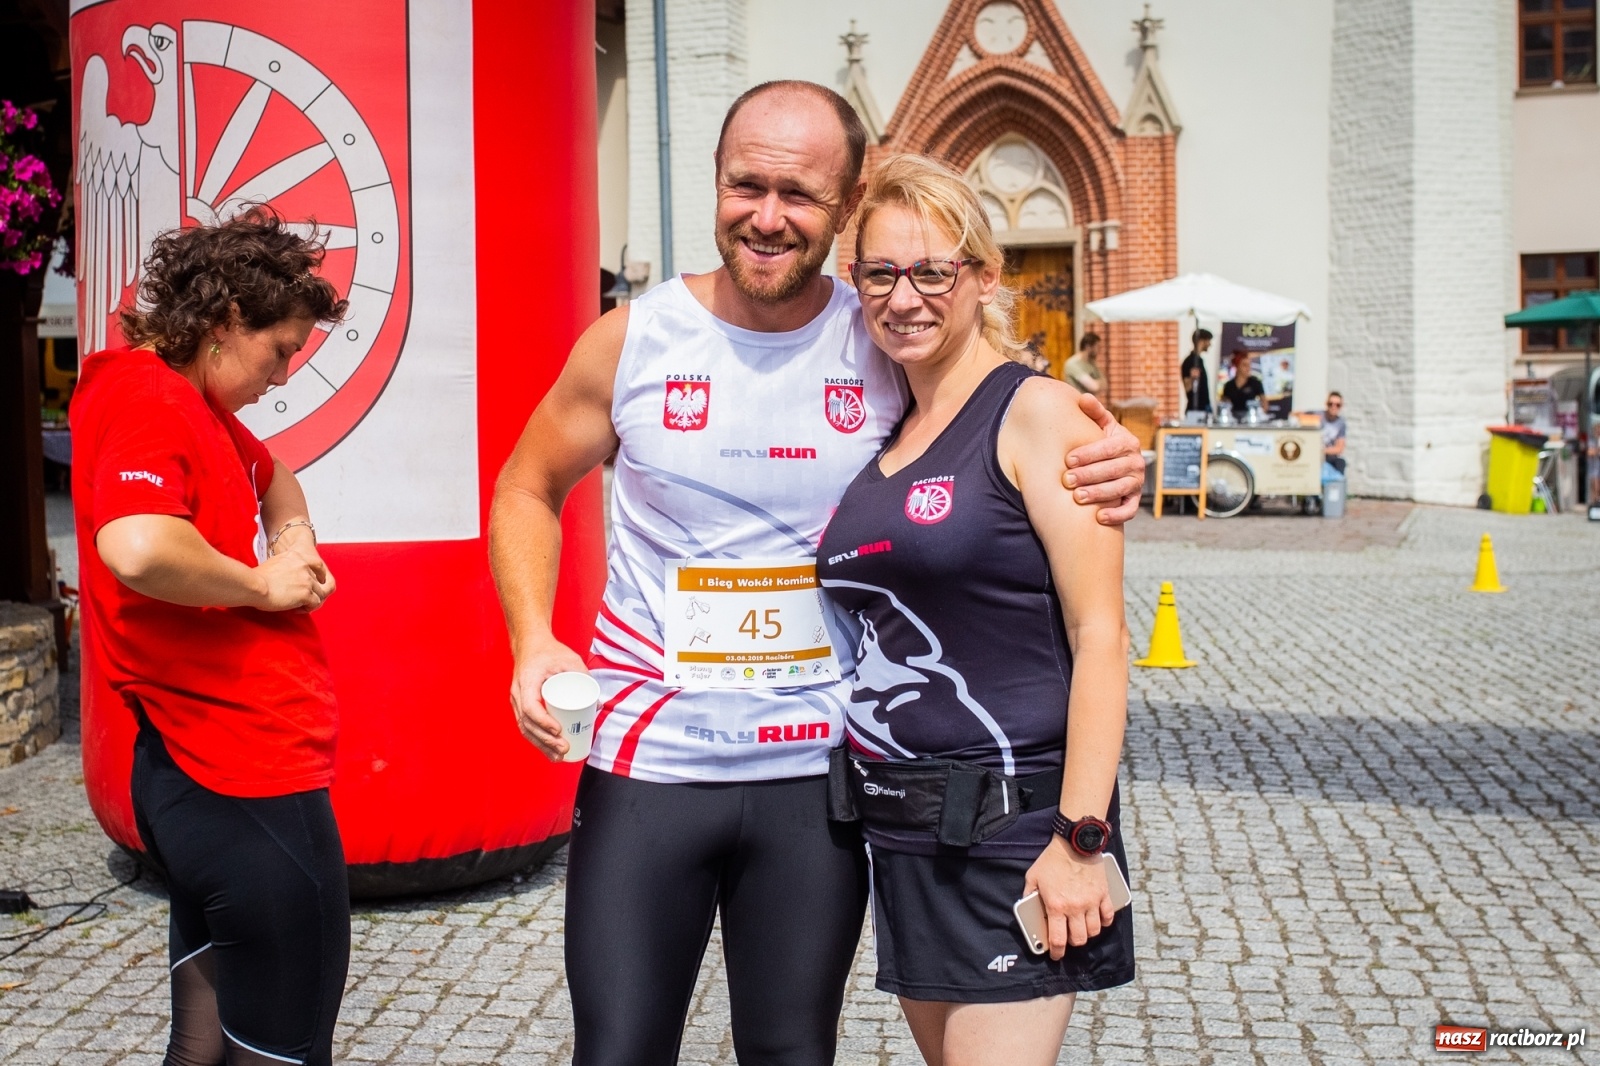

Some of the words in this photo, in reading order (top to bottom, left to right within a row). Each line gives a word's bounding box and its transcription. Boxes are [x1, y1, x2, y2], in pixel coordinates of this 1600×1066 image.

[666, 374, 711, 382] POLSKA
[824, 377, 864, 386] RACIBÓRZ
[119, 470, 164, 487] TYSKIE
[912, 475, 955, 487] RACIBÓRZ
[707, 577, 733, 589] Bieg
[737, 577, 773, 587] Wokół
[776, 575, 815, 586] Komina
[738, 608, 782, 640] 45
[765, 653, 795, 661] Racibórz
[878, 786, 906, 799] Kalenji
[987, 954, 1018, 973] 4F
